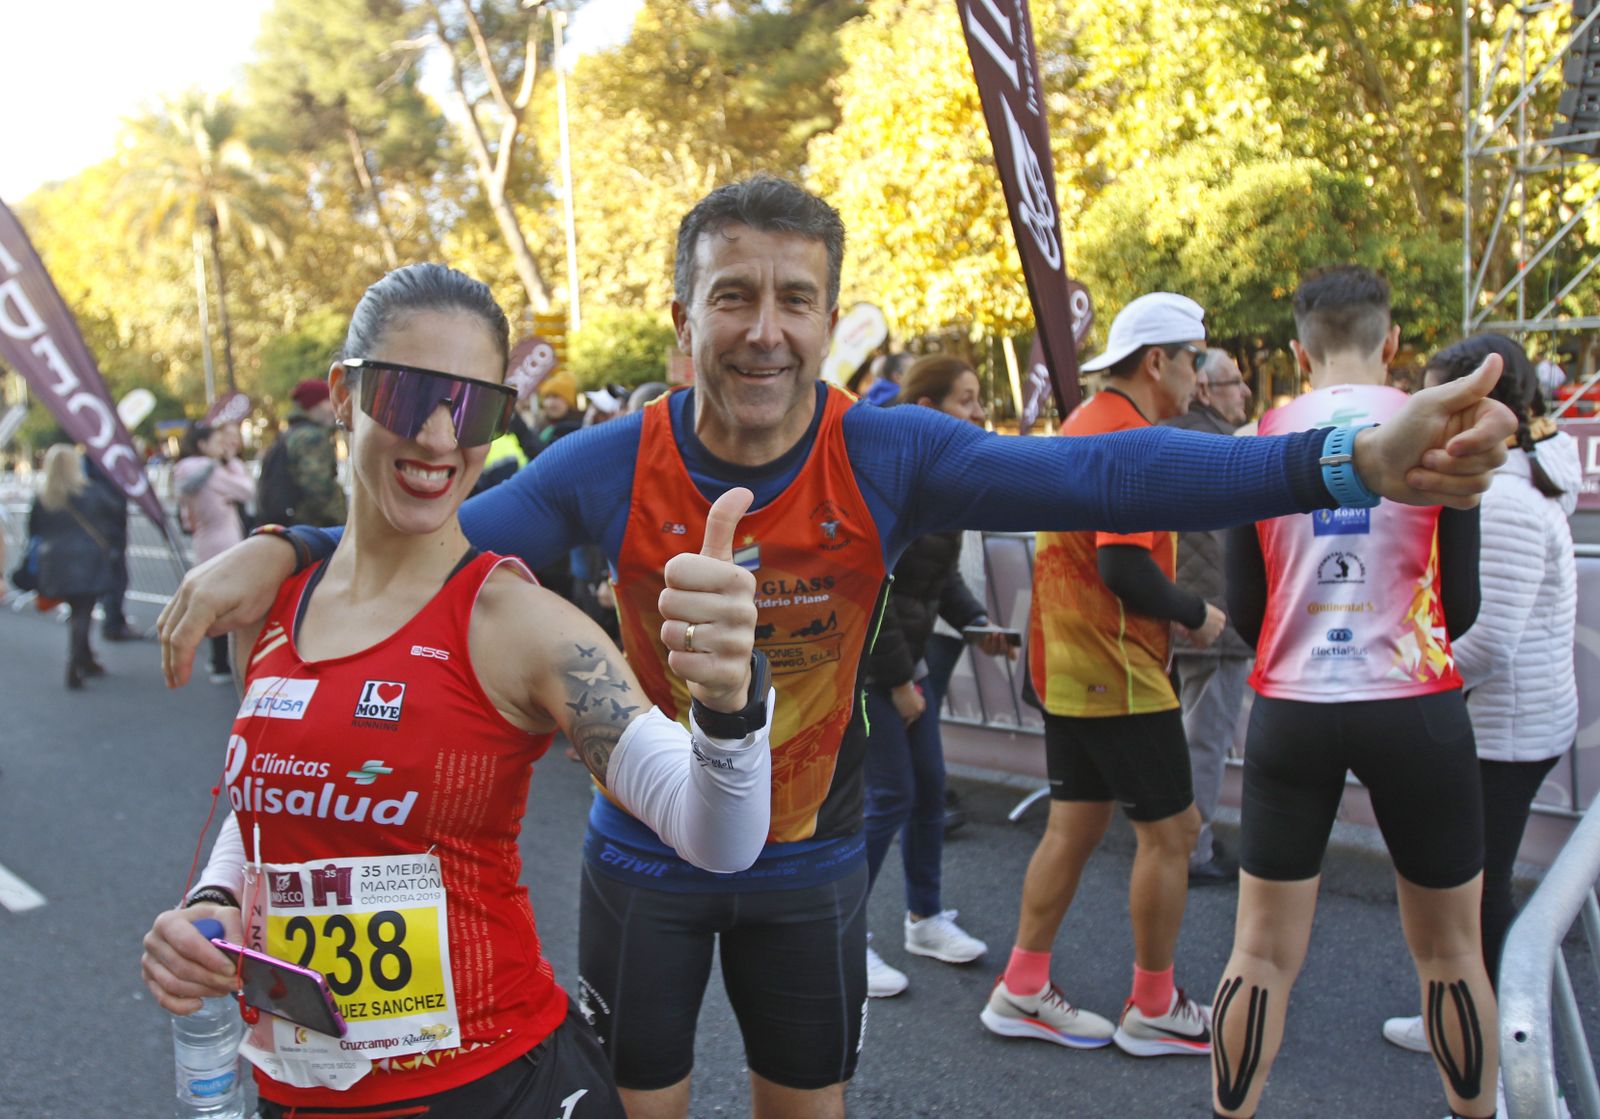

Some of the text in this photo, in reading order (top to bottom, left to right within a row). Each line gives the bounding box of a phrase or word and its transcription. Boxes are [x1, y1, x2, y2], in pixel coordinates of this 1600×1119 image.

[762, 576, 836, 596] GLASS
[794, 594, 830, 606] Plano
[363, 683, 375, 702] I
[356, 704, 400, 718] MOVE
[352, 720, 398, 732] RUNNING
[252, 753, 330, 778] Clínicas
[324, 870, 336, 878] 35
[361, 863, 438, 878] 35 MEDIA
[360, 878, 441, 892] MARATÓN
[285, 910, 412, 996] 238
[372, 994, 445, 1016] SANCHEZ
[340, 1038, 398, 1050] Cruzcampo
[402, 1034, 436, 1046] Radler
